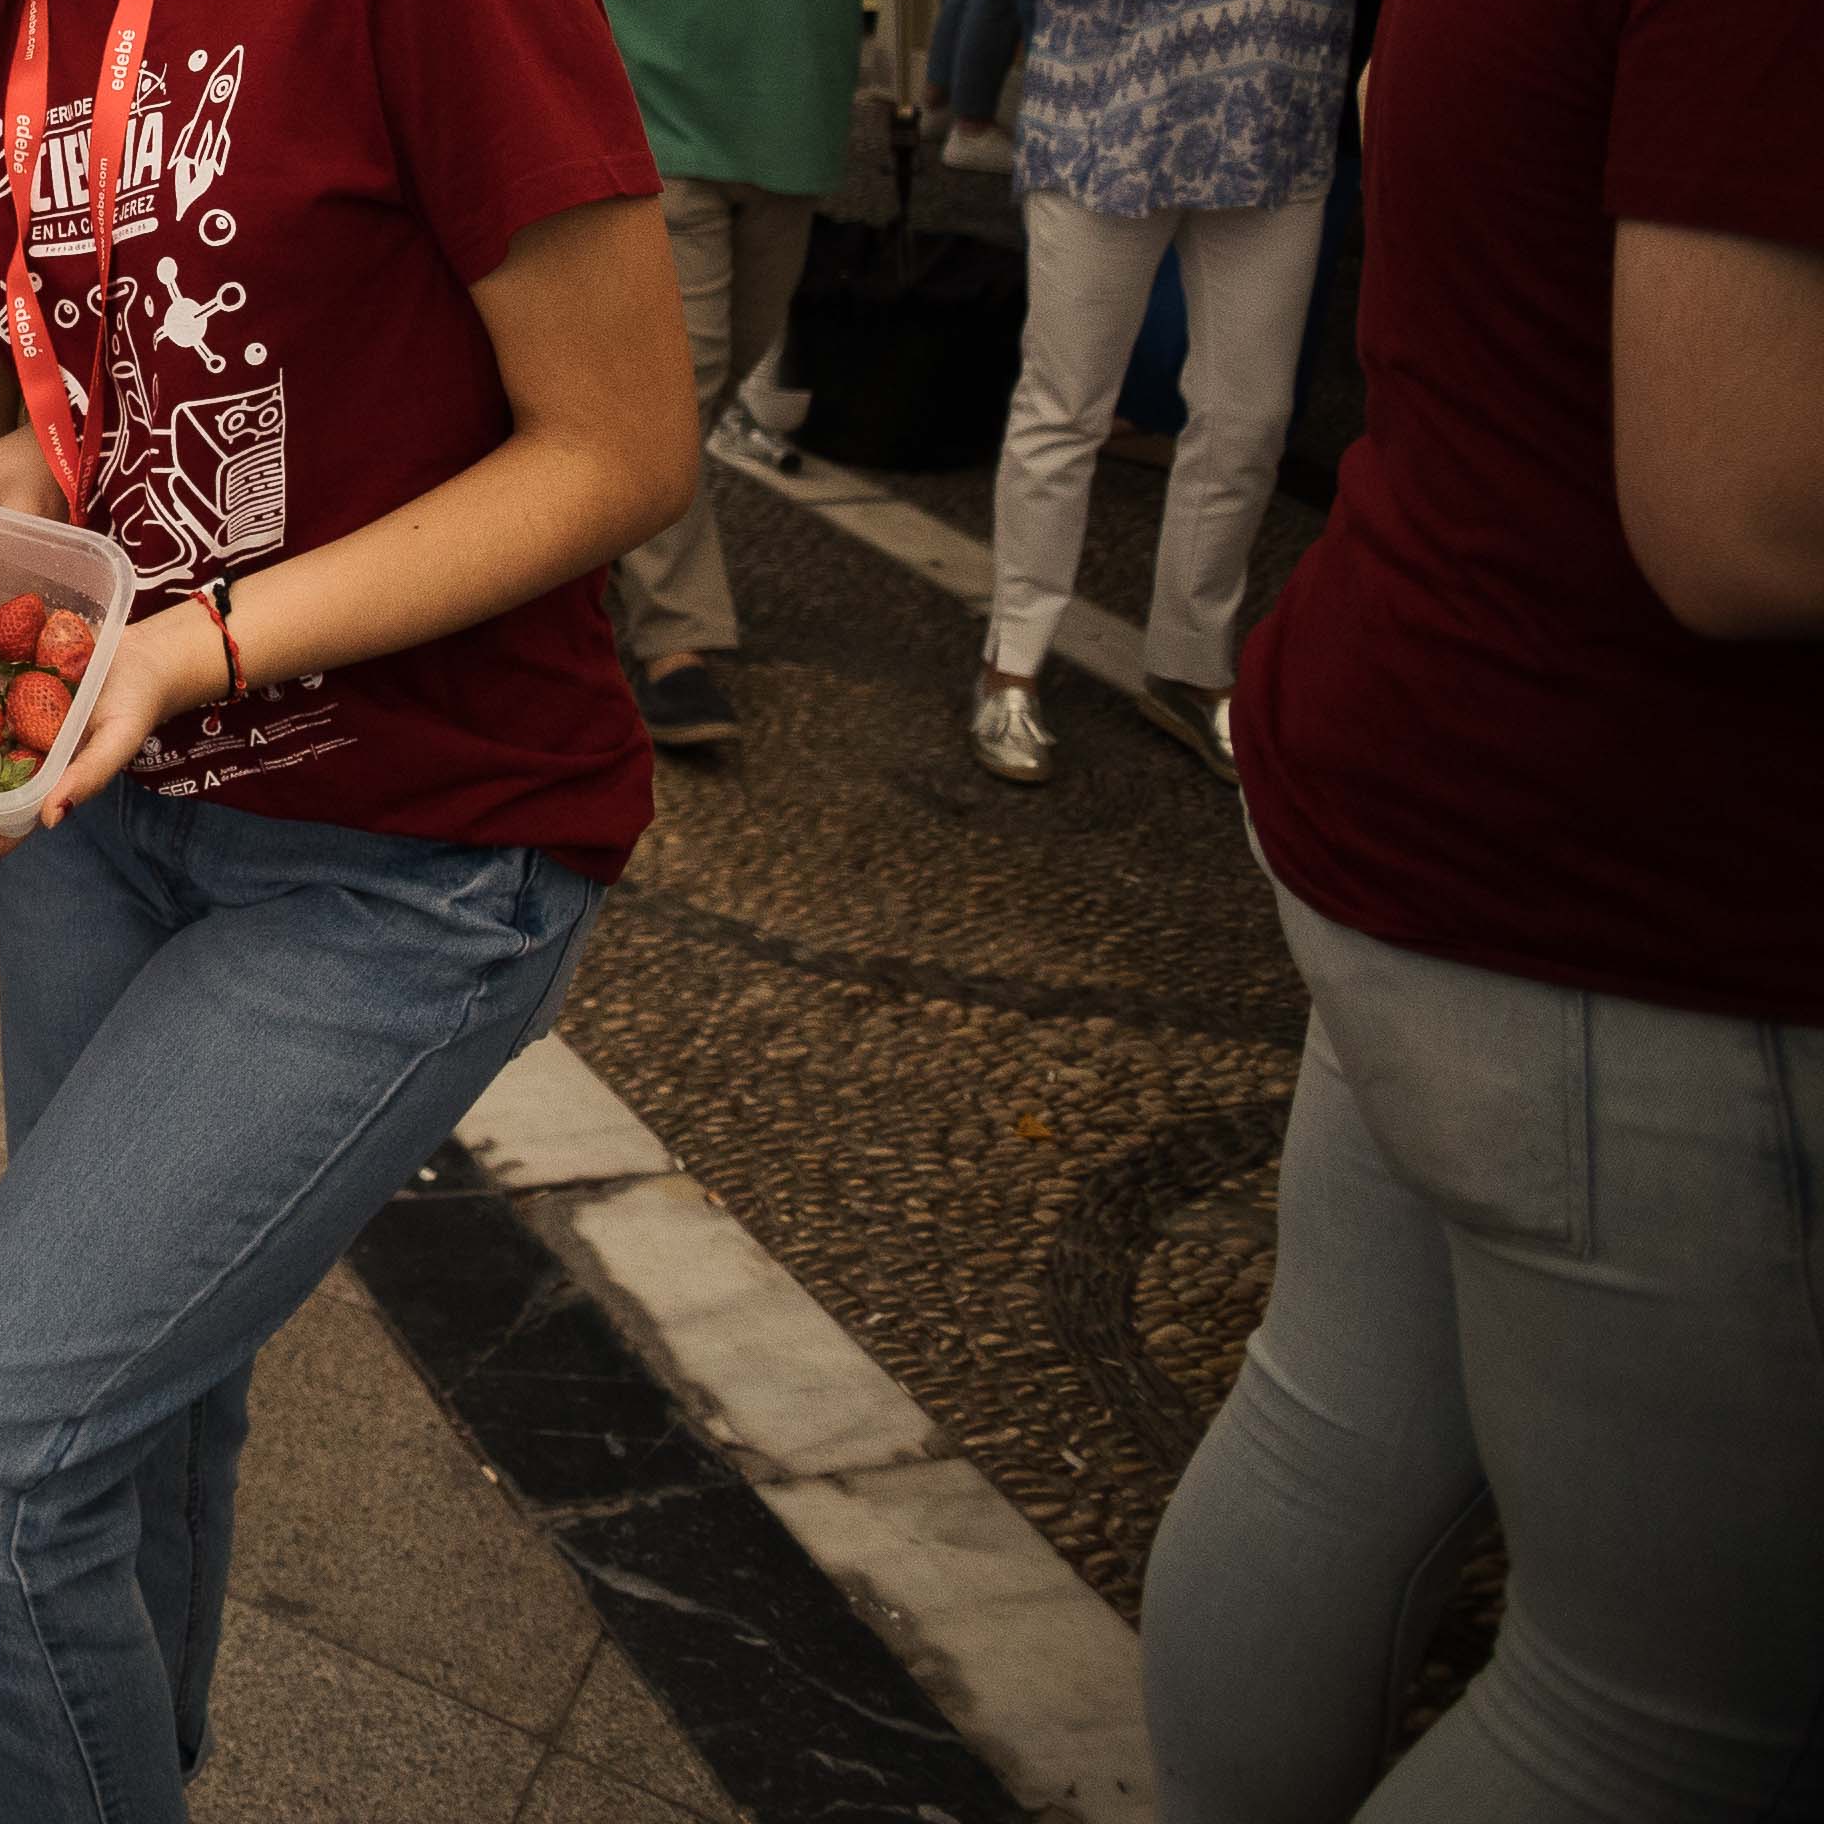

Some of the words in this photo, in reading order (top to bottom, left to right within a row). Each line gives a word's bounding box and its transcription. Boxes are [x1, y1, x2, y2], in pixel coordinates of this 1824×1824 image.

[111, 28, 135, 91] edebé
[74, 98, 92, 116] DE
[13, 115, 33, 175] edebé
[32, 224, 53, 241] EN
[58, 220, 77, 238] LA
[120, 194, 154, 220] JEREZ
[14, 297, 43, 358] edebé
